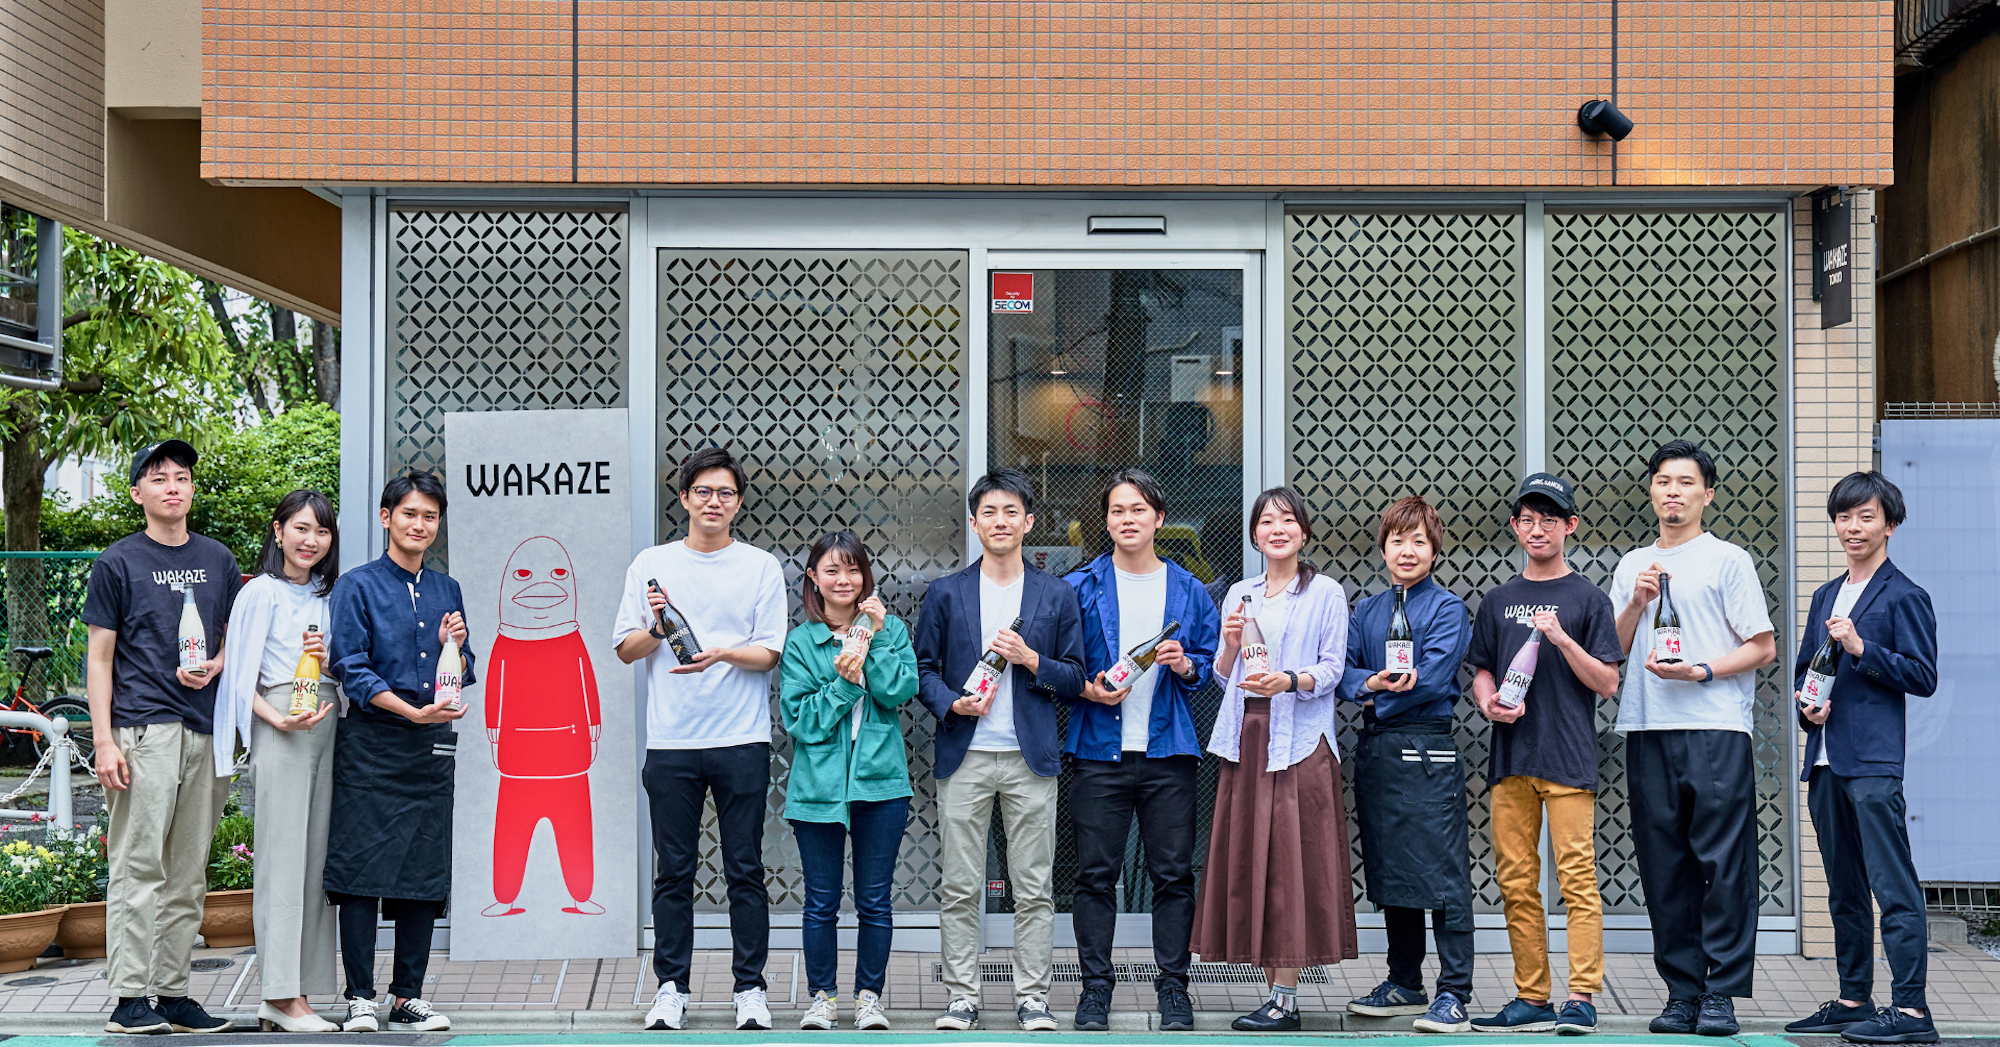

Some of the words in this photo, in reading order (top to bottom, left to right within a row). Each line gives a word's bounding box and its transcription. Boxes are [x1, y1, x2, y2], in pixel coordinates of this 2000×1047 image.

[1823, 243, 1848, 272] WAKAZE
[994, 300, 1031, 310] SECOM
[466, 461, 610, 497] WAKAZE
[152, 569, 207, 585] WAKAZE
[667, 626, 691, 644] WAKAZE
[1656, 627, 1681, 636] WAKAZE
[1387, 641, 1412, 649] WAKAZE
[977, 662, 1001, 679] WAKAZE
